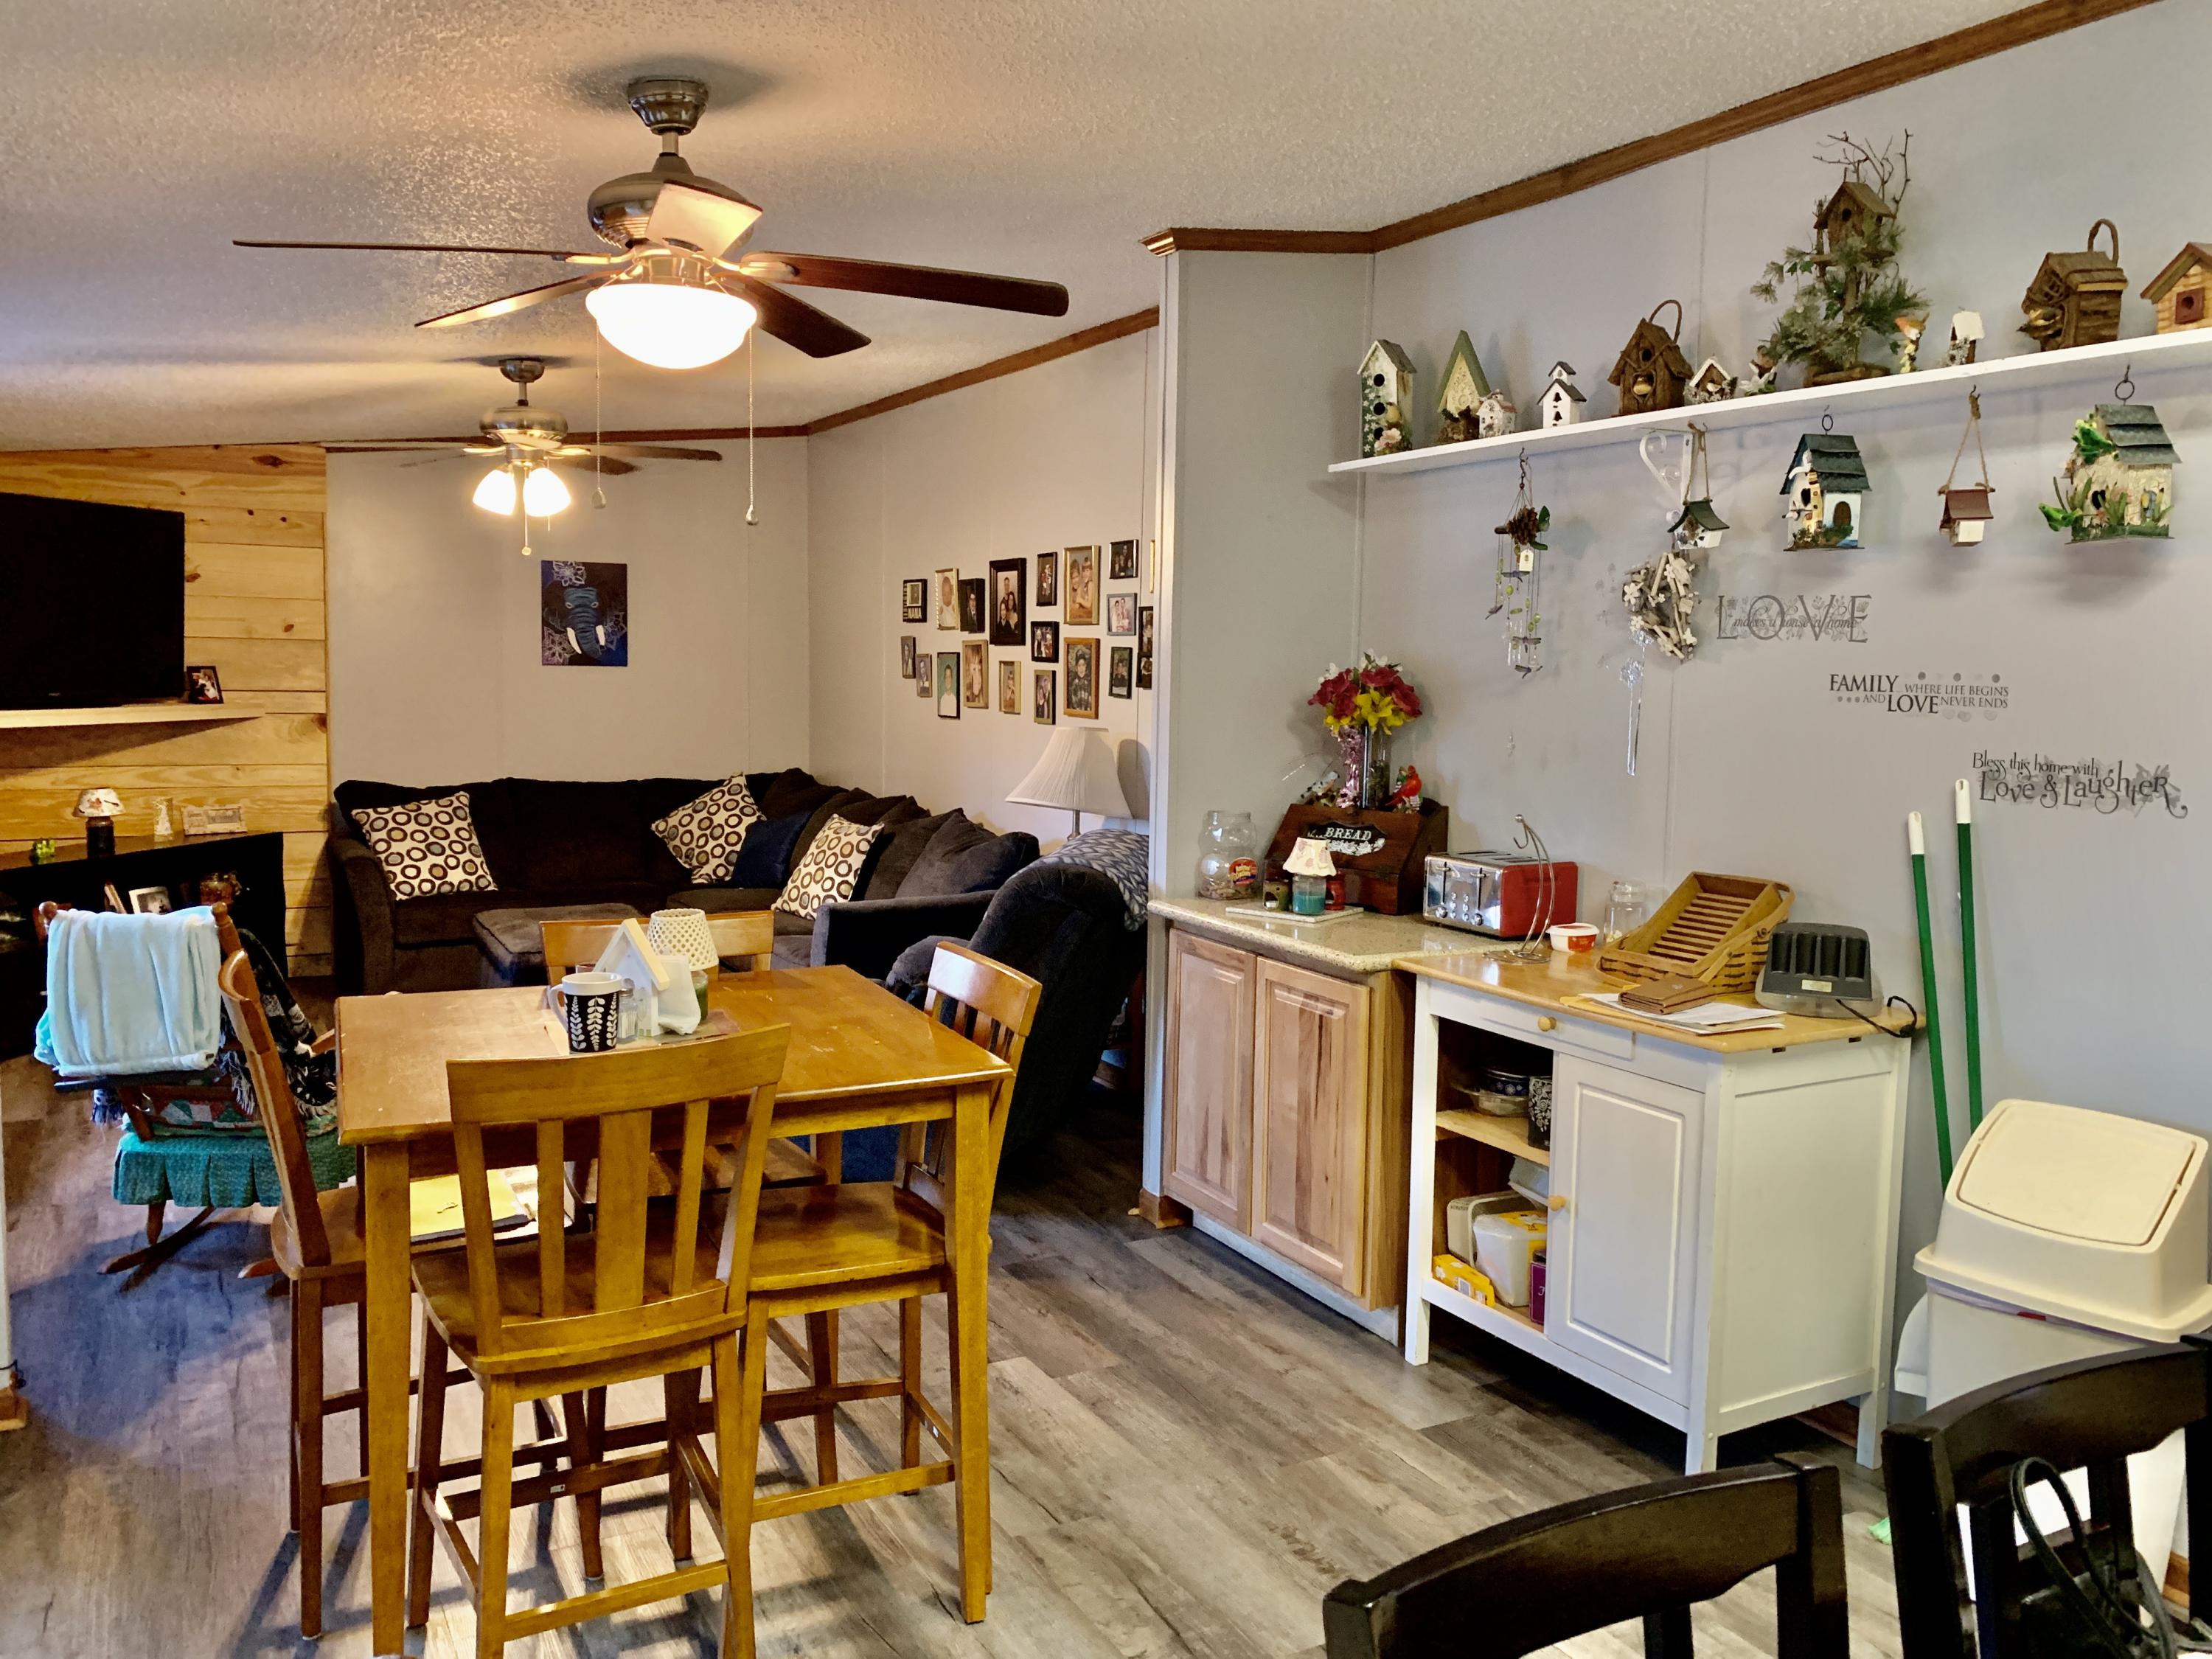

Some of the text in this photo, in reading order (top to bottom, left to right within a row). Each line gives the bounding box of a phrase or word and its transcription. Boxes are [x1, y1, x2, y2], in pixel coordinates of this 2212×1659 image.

[1716, 594, 1872, 643] LOVE
[1829, 674, 2008, 697] FAMILY WHERE LIFE BEGINS
[1863, 694, 2008, 714] AND LOVE NEVER ENDS
[1972, 749, 2099, 782] Bless this home with
[1980, 771, 2035, 802] Love
[2039, 774, 2058, 808] &
[1324, 827, 1371, 841] BREAD
